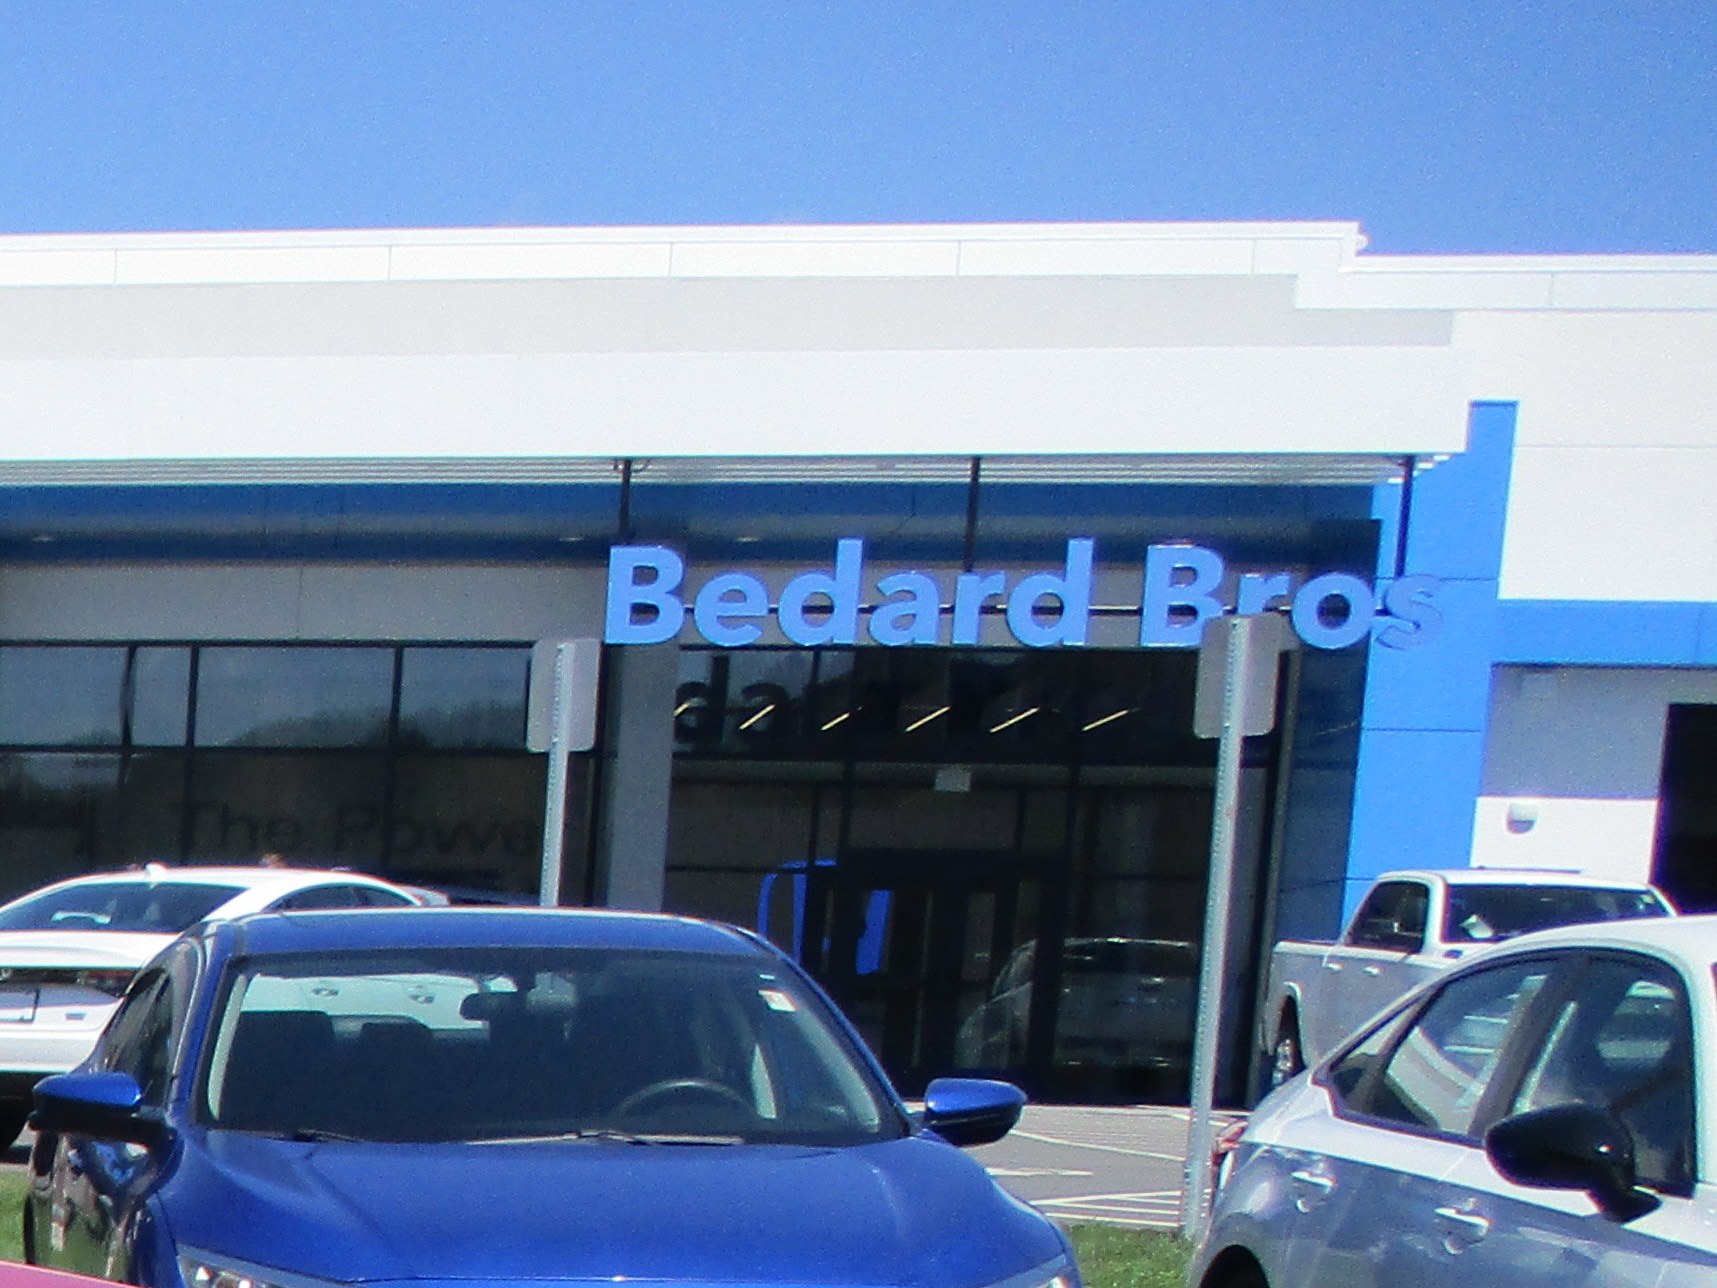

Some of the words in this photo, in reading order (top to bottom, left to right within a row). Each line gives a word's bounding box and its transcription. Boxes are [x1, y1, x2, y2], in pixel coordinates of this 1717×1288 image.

[604, 537, 1095, 648] Bedard
[1140, 542, 1443, 650] Bros
[334, 801, 540, 857] Powe
